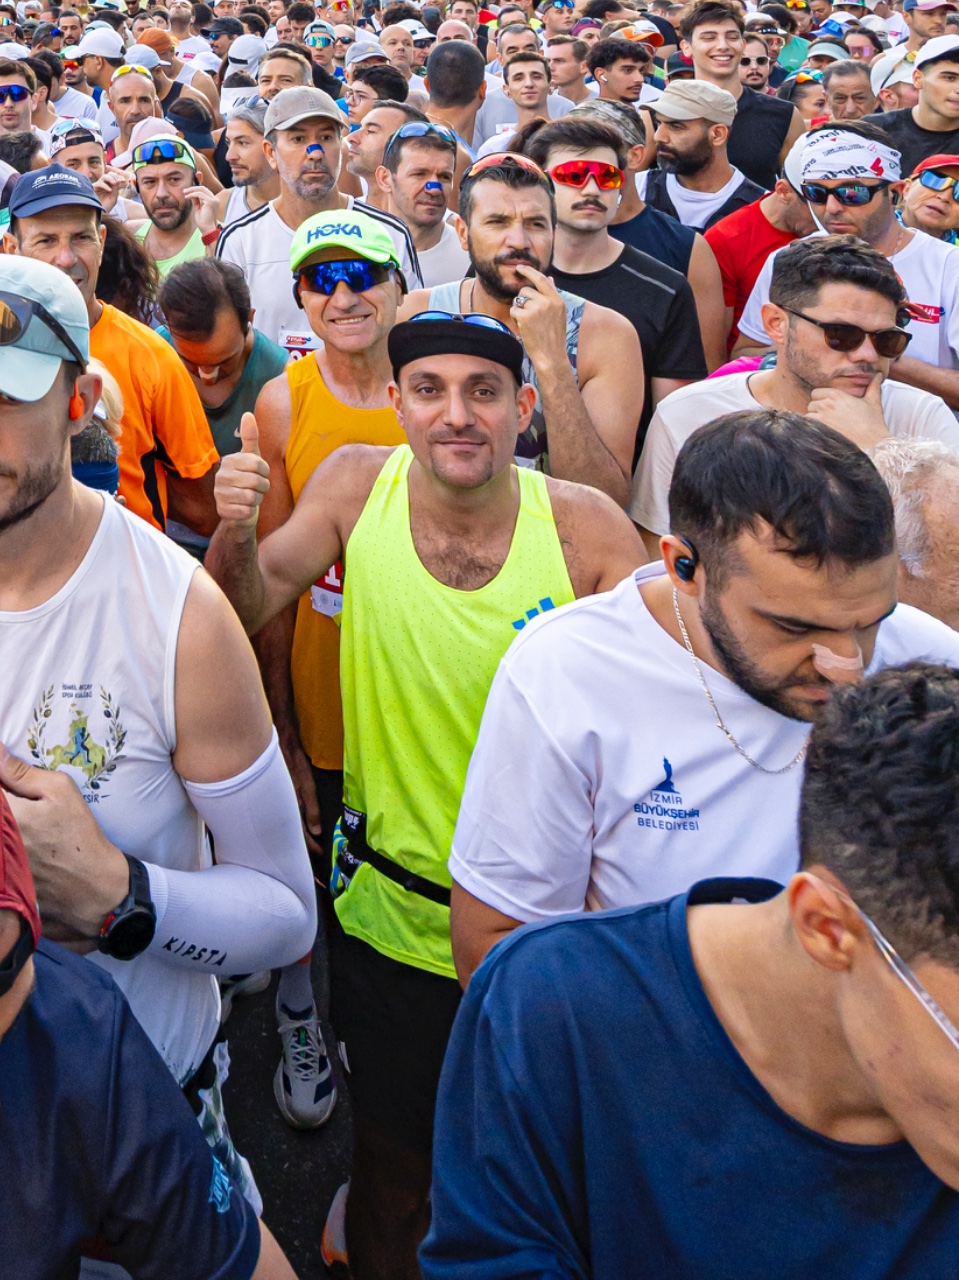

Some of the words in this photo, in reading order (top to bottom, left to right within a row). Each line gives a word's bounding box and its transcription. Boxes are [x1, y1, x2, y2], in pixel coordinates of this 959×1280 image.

[307, 223, 363, 244] HOKA
[649, 790, 683, 804] İZMİR
[634, 802, 700, 819] BÜYÜKŞEHİR
[637, 817, 700, 831] BELEDİYESİ
[162, 936, 228, 967] KIPSTA
